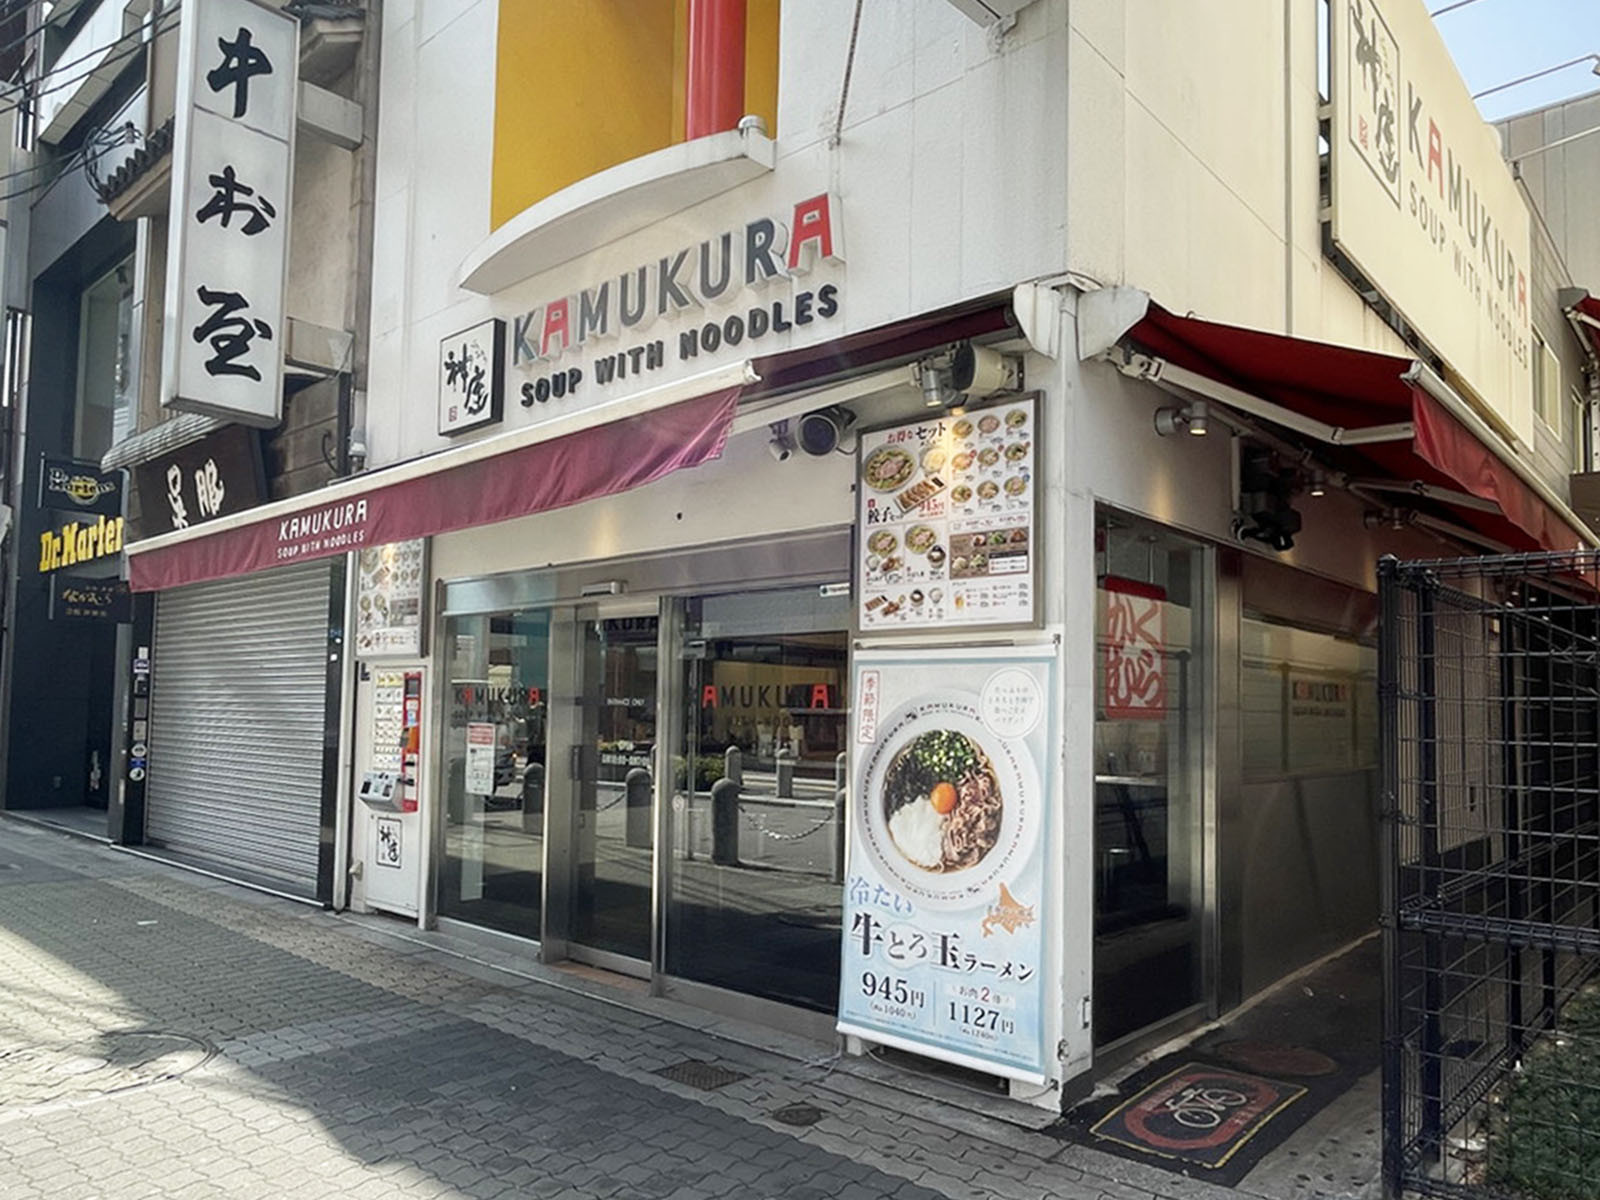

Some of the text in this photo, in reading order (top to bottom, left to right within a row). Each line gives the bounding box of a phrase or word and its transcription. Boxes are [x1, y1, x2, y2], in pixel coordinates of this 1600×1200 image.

[1407, 80, 1528, 328] KAMUKURA
[512, 192, 836, 367] KAMUKURA
[1410, 180, 1528, 370] SOUP WITH NOODLES
[520, 284, 839, 408] SOUP WITH NOODLES
[277, 530, 366, 560] SOUP WITH NOODLES
[278, 499, 368, 542] KAMUKURA
[850, 876, 913, 913] 冷たい
[851, 912, 1035, 981] 牛とろ玉ラーメン
[862, 971, 925, 1009] 945円
[949, 1001, 1015, 1035] 1127円
